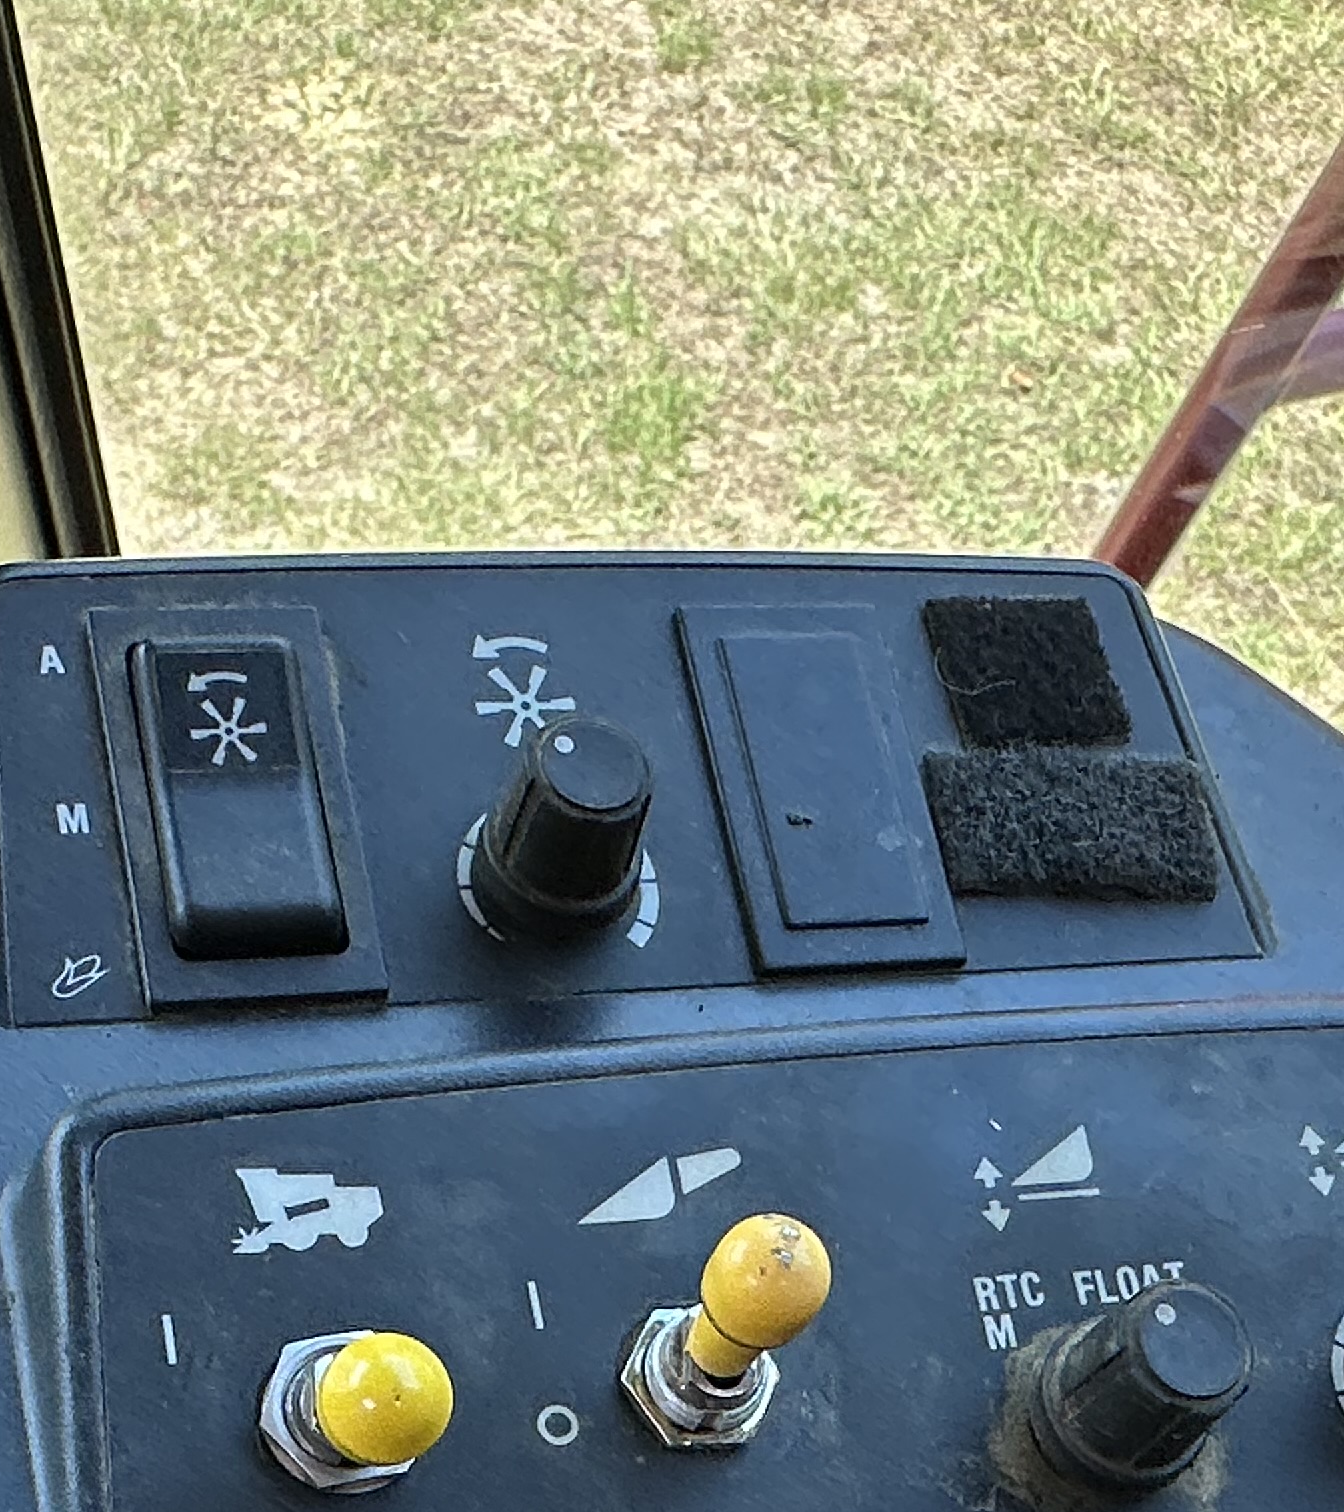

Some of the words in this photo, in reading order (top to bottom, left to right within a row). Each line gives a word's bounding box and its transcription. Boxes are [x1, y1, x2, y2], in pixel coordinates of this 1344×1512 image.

[40, 645, 66, 674] A
[56, 803, 90, 834] M
[973, 1271, 1044, 1311] RTC
[982, 1312, 1017, 1350] M
